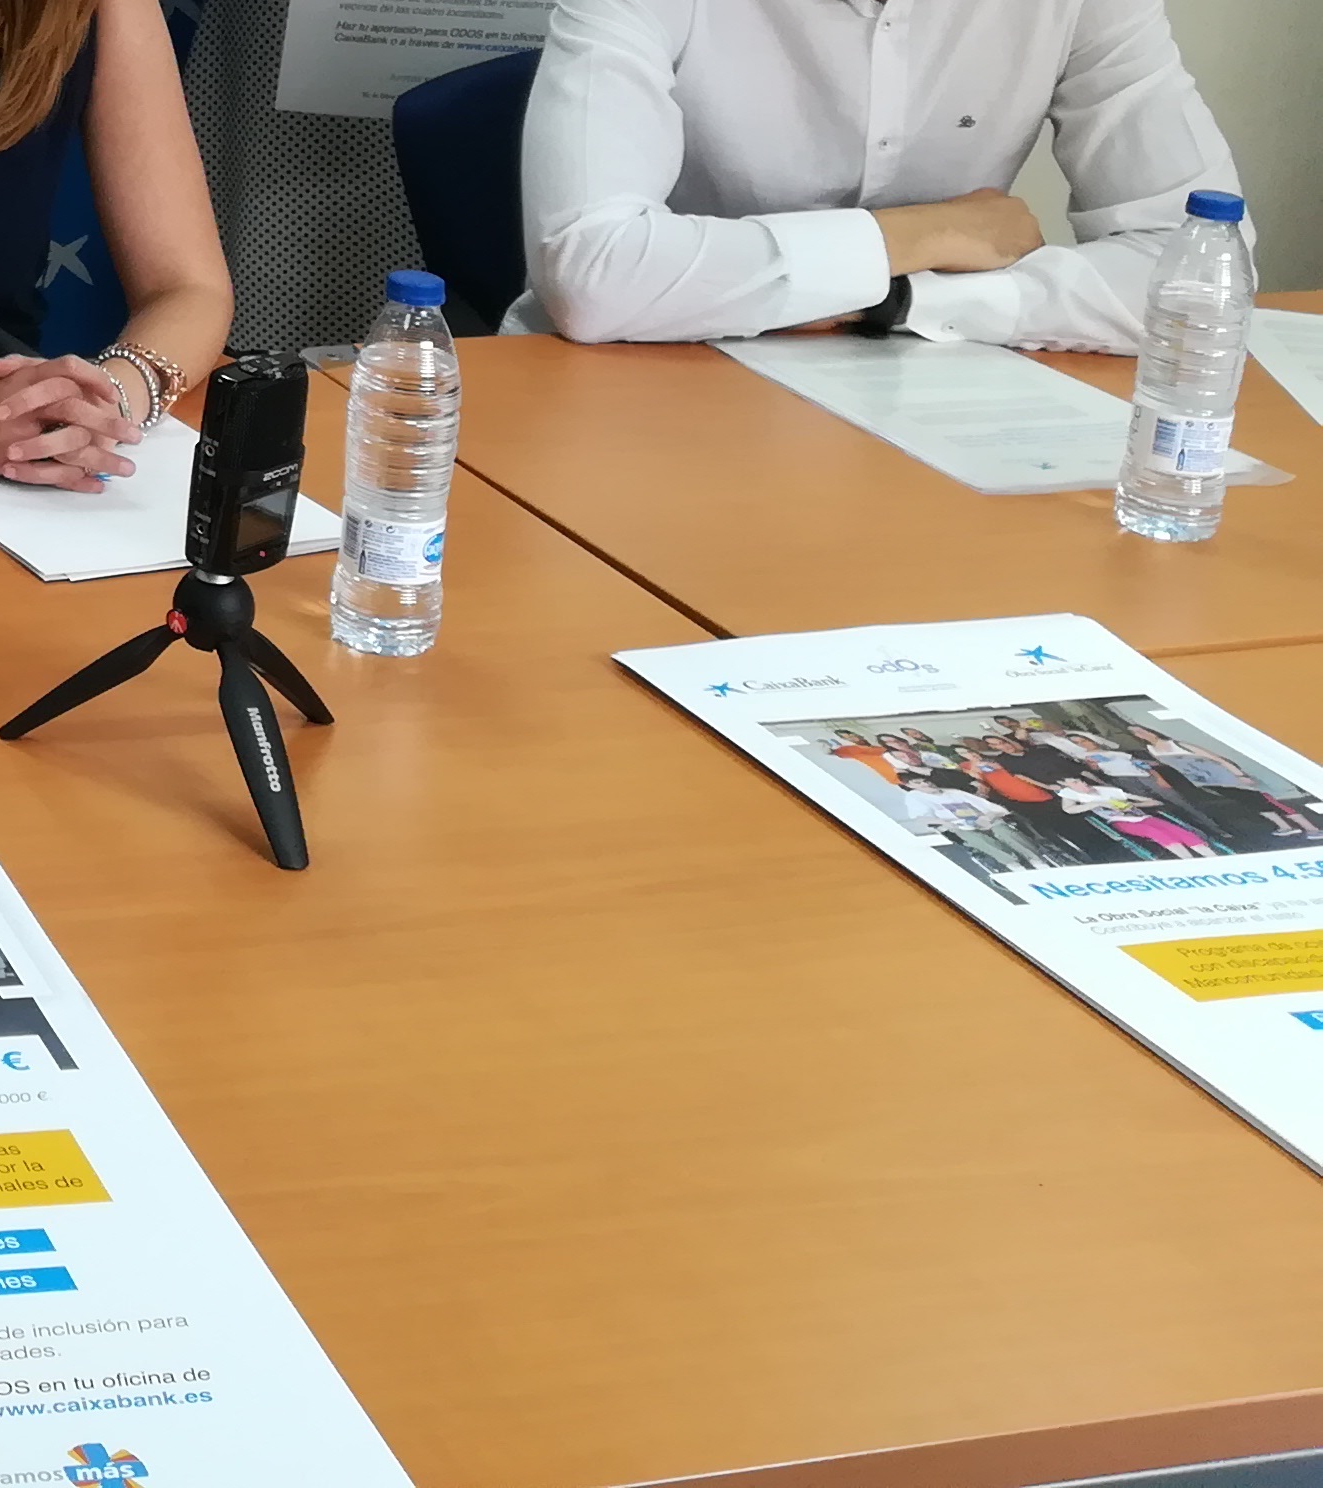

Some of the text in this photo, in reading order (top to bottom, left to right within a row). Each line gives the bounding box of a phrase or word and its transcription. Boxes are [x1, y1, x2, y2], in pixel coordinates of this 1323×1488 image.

[743, 675, 845, 692] CaixaBank
[246, 707, 282, 792] Manfrotto
[1028, 866, 1269, 900] Necesitamos
[0, 1050, 31, 1071] €
[37, 1091, 49, 1102] €
[22, 1159, 45, 1172] la
[54, 1175, 83, 1188] de
[31, 1318, 131, 1338] inclusión
[136, 1316, 189, 1333] para
[37, 1380, 67, 1393] en
[73, 1376, 95, 1390] tu
[101, 1370, 177, 1388] oficina
[182, 1366, 211, 1382] de
[76, 1461, 136, 1482] más
